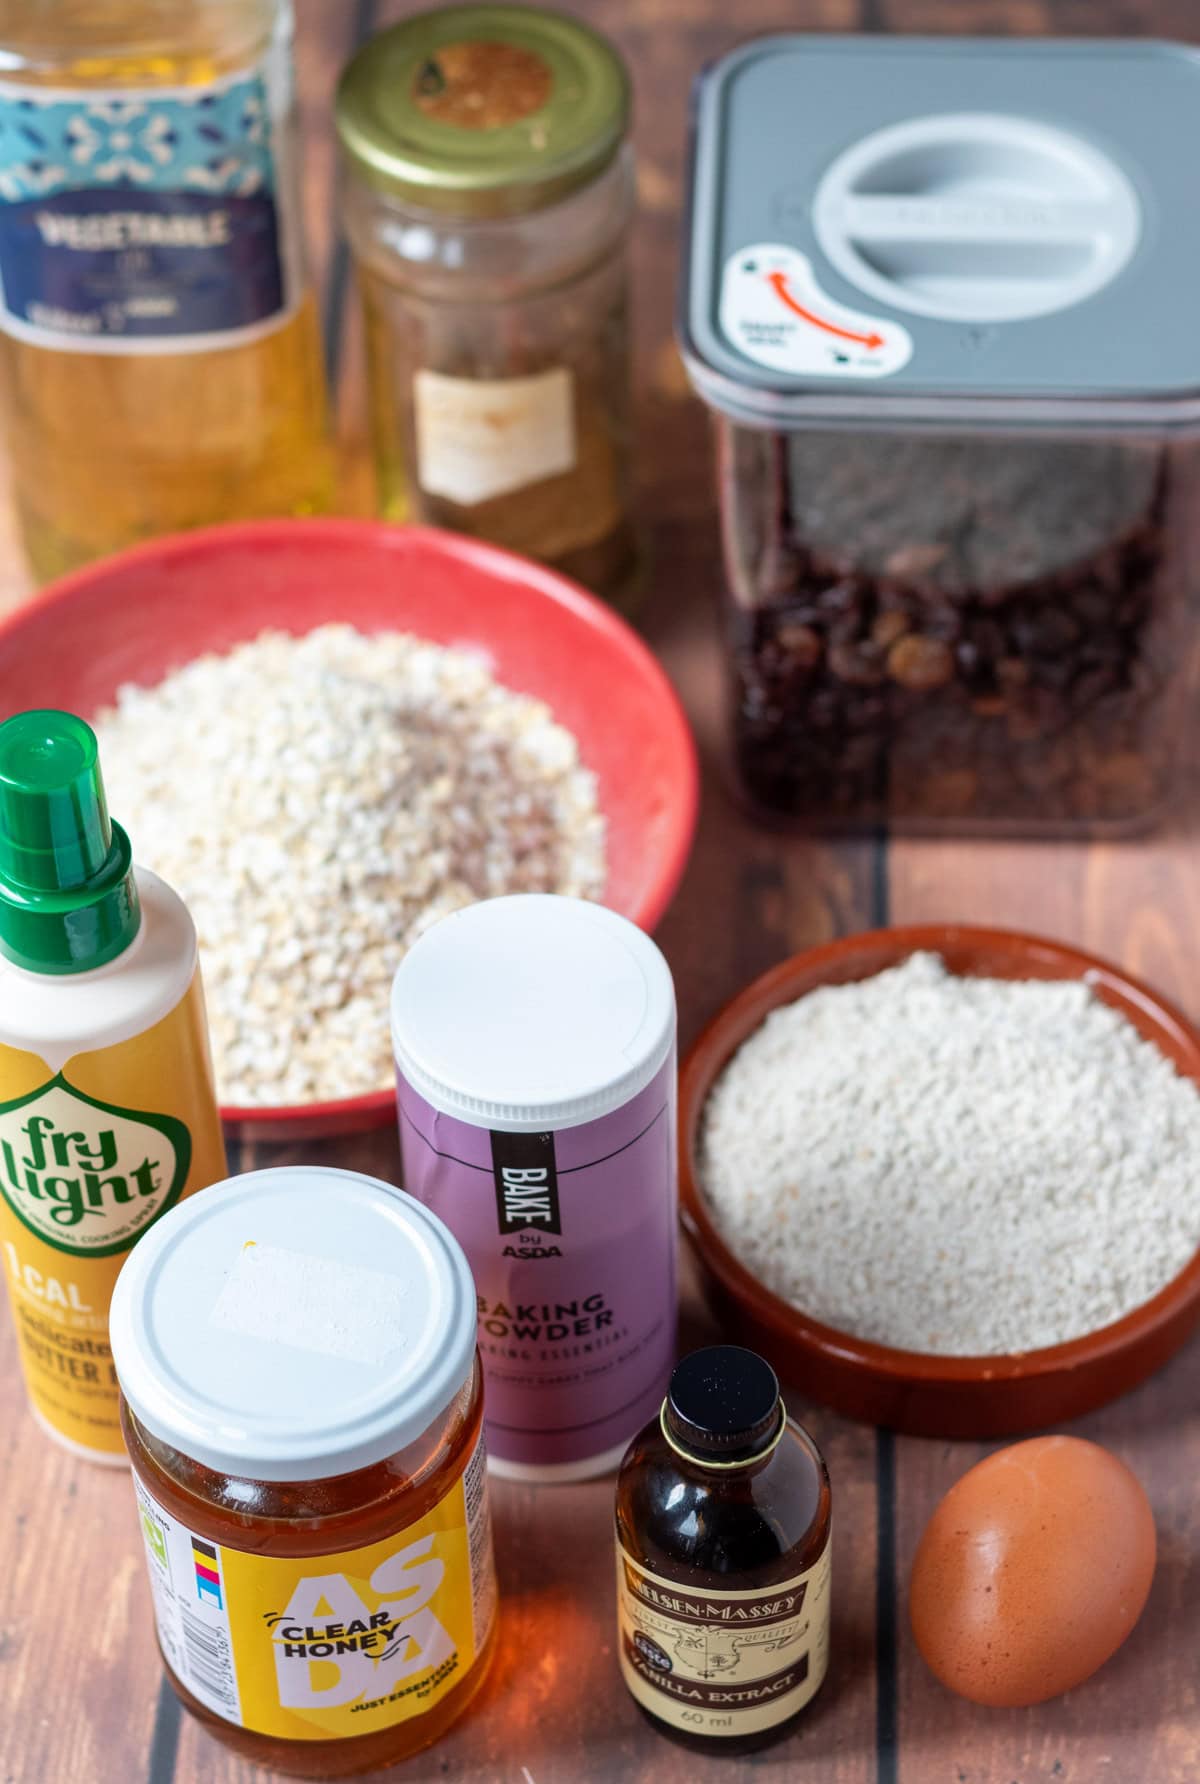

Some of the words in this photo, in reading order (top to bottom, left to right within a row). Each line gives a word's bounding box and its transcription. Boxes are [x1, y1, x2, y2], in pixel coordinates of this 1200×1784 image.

[22, 1116, 118, 1171] fry
[1, 1138, 161, 1226] light
[502, 1167, 552, 1223] BAKE
[502, 1245, 562, 1260] ASDA
[519, 1233, 541, 1246] by
[477, 1309, 614, 1341] OWDER
[281, 1611, 392, 1642] CLEAR
[284, 1621, 401, 1659] HONEY
[708, 1672, 795, 1703] EXTRACT
[350, 1697, 386, 1712] JUST
[680, 1710, 704, 1725] 60
[709, 1716, 733, 1727] ml
